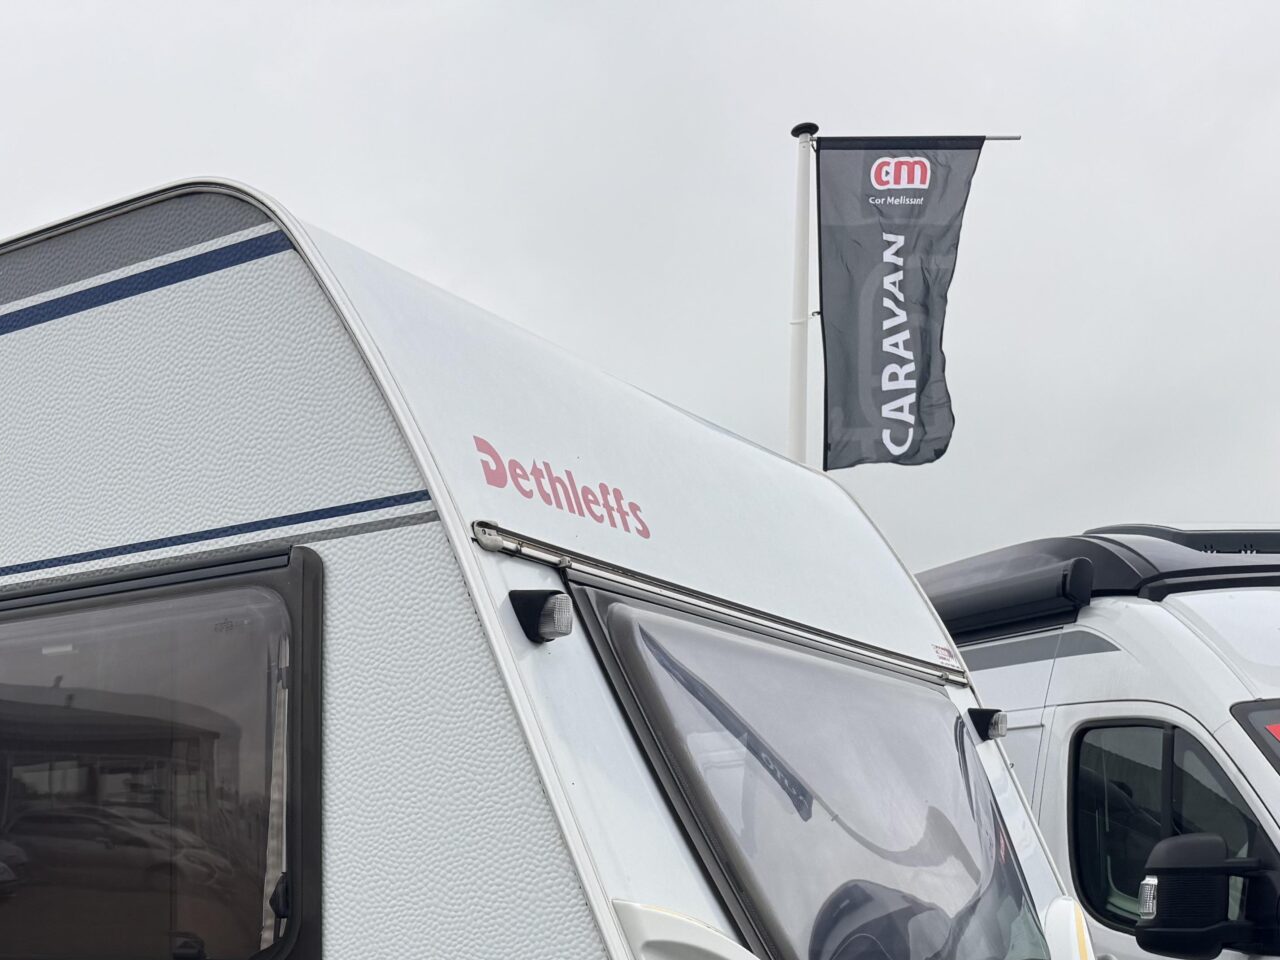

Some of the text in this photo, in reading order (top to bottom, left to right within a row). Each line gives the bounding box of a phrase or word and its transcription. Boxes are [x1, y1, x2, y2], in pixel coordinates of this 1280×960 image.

[868, 195, 924, 205] Cor Melissant
[881, 232, 917, 456] CARAVAN
[473, 436, 651, 539] Dethleffs
